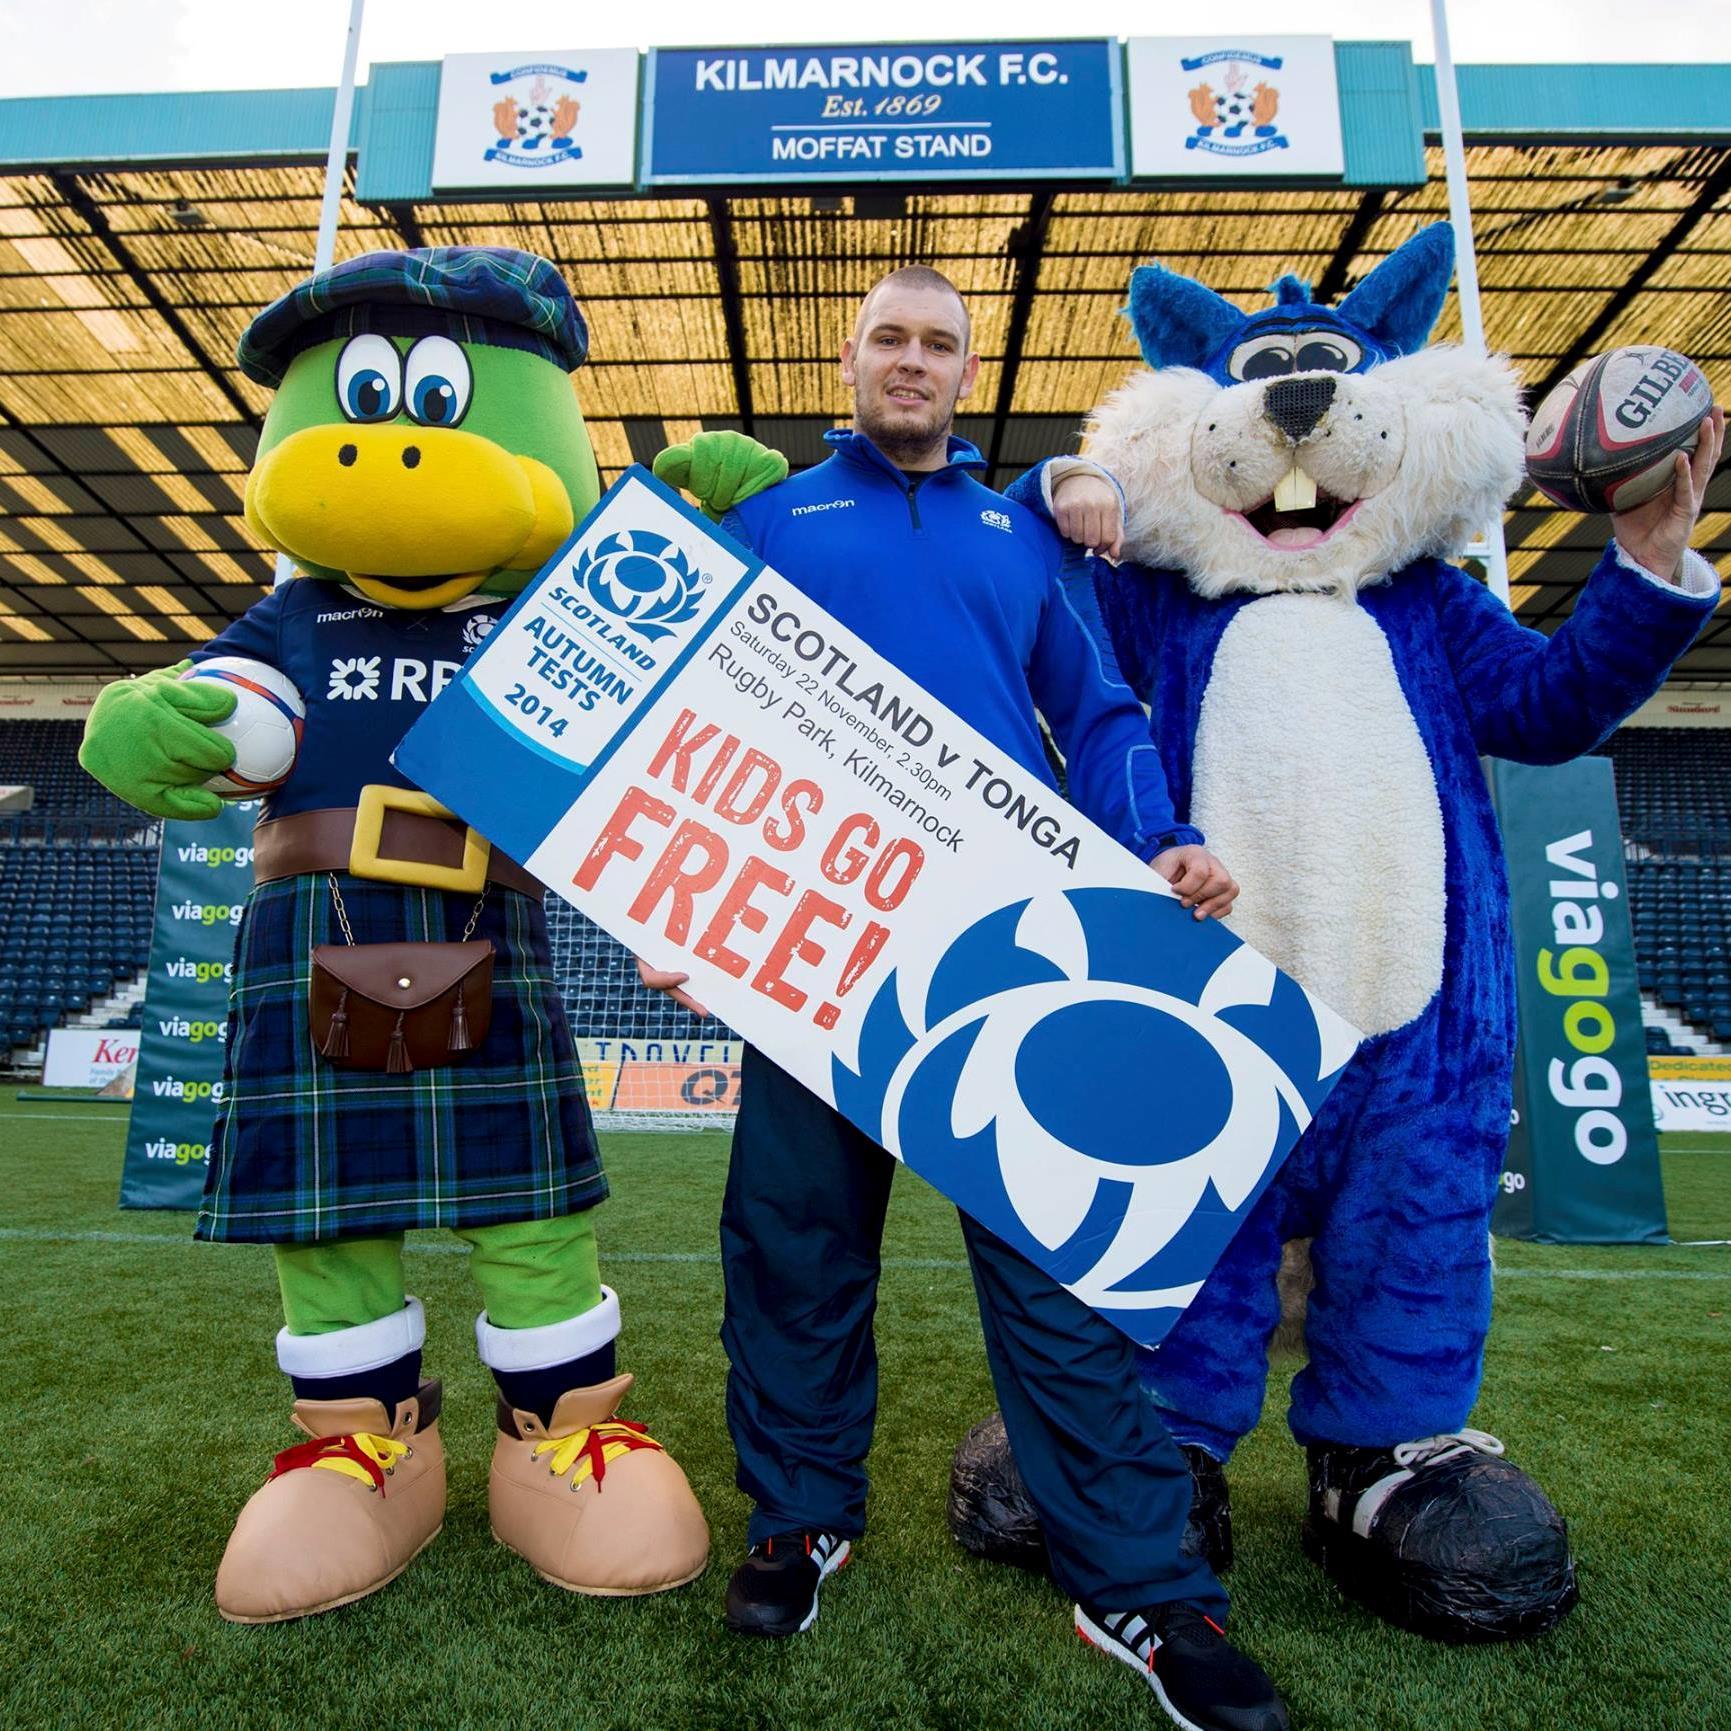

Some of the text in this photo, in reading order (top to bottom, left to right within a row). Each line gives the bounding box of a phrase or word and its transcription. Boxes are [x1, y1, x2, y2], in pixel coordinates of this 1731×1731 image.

[695, 52, 1068, 91] KILMARNOCK F.C.
[820, 94, 942, 118] Est. 1869
[772, 134, 992, 160] MOFFAT STAND
[1615, 350, 1689, 429] GILBE
[792, 499, 855, 516] macron
[316, 607, 384, 624] macron
[548, 586, 657, 671] SCOTLAND
[523, 615, 634, 706] AUTUMN
[526, 646, 601, 712] TESTS
[504, 683, 569, 738] 2014
[730, 620, 953, 801] Saturday 22 November, 2.30pm
[747, 592, 1082, 870] SCOTLAND v TONGA
[708, 643, 965, 854] Rugby Park, Kilmarnock
[646, 708, 925, 913] KIDS GO
[172, 900, 244, 926] viagog
[571, 785, 891, 1031] FREE!
[165, 957, 234, 983] viagog
[1537, 829, 1628, 1166] viagogo
[159, 1015, 228, 1043] viagog
[152, 1076, 224, 1103] viagog
[1650, 1060, 1731, 1071] Dedicate
